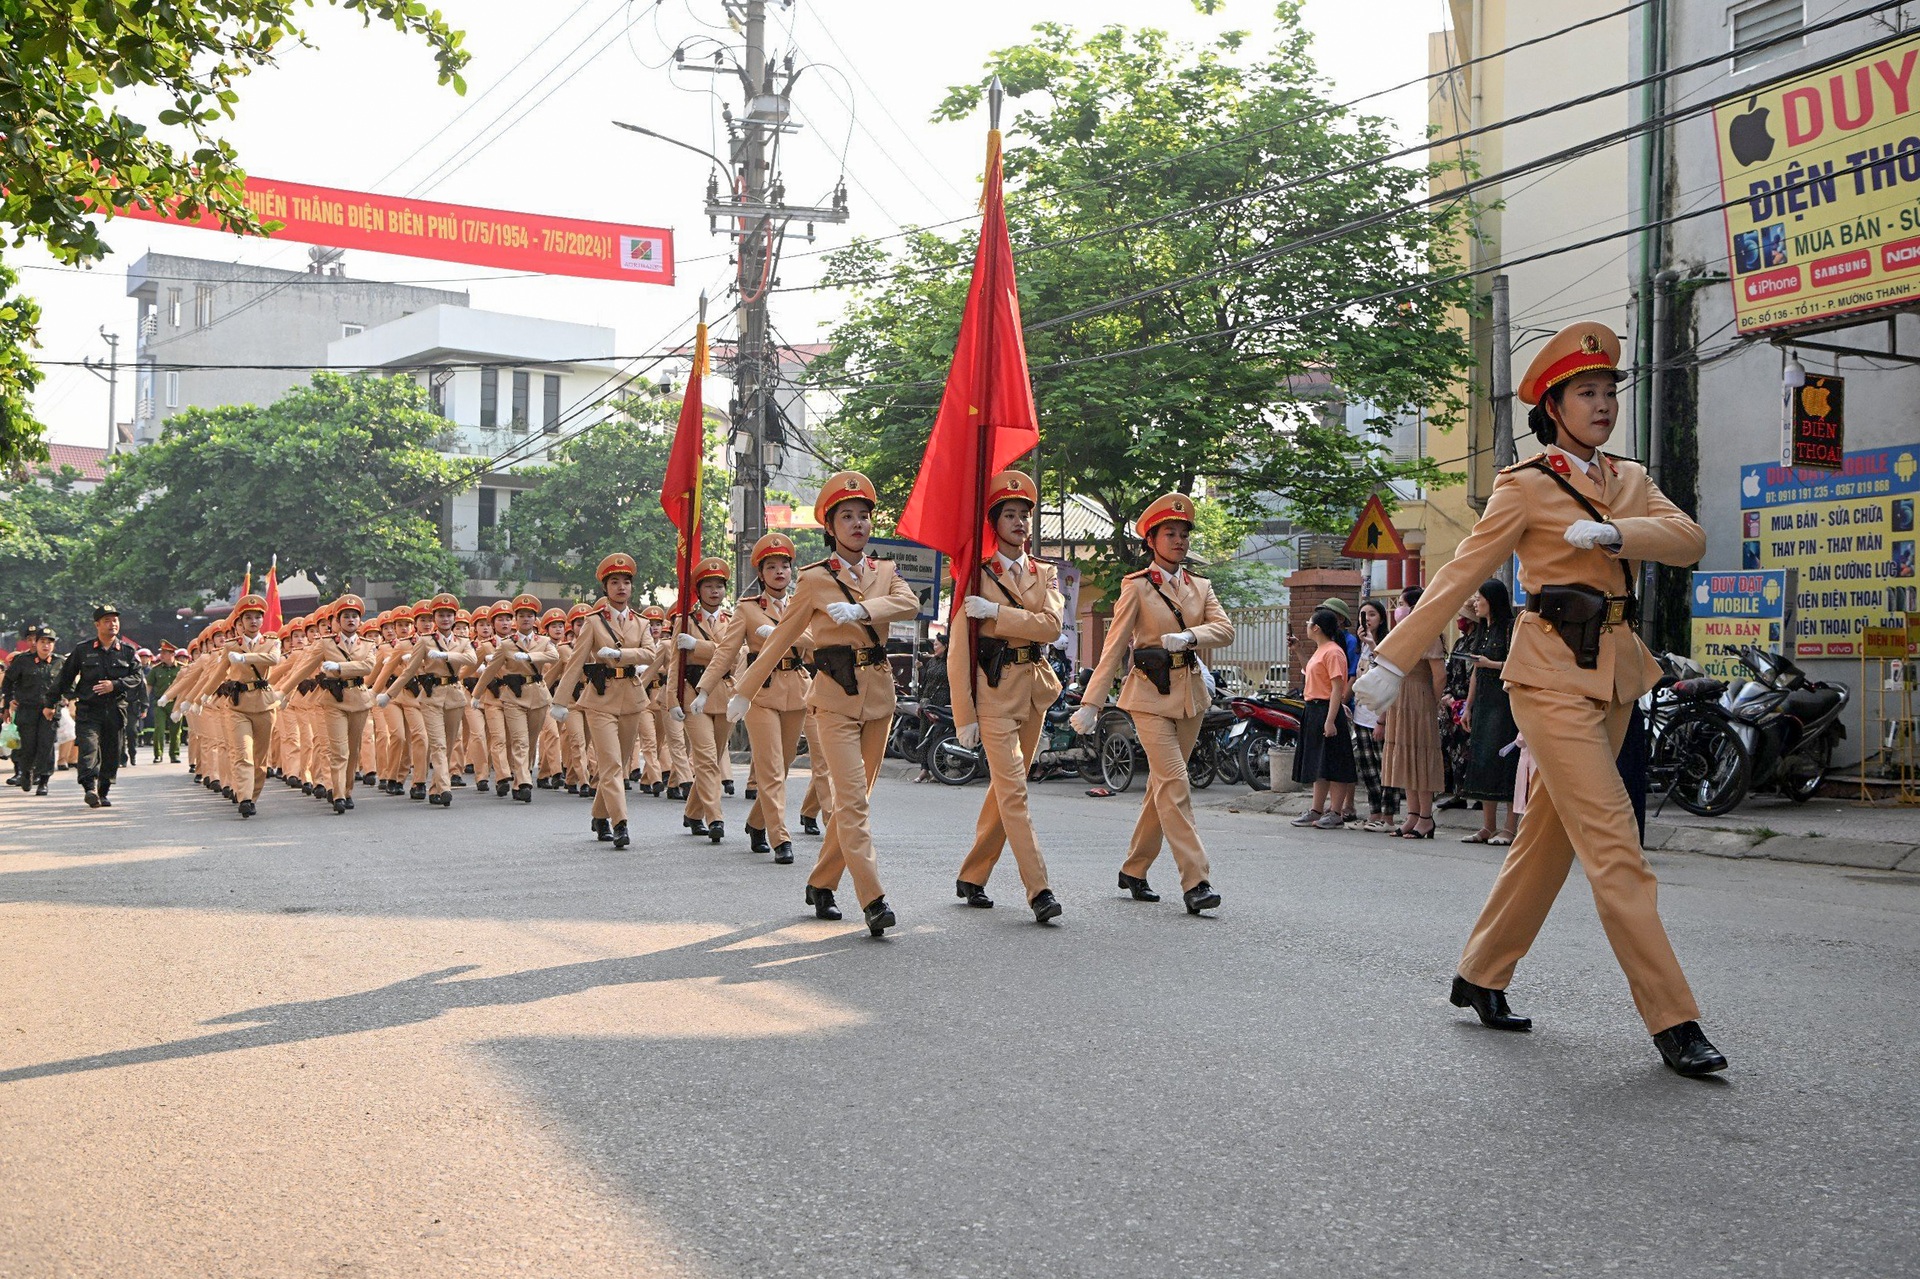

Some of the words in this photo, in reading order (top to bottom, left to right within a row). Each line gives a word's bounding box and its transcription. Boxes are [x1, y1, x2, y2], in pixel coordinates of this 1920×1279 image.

[1782, 49, 1919, 148] DUY
[1749, 160, 1837, 222] ĐIỆN
[292, 195, 344, 226] THẮNG
[347, 202, 385, 233] ĐIỆN
[388, 208, 424, 238] BIÊN
[428, 213, 458, 241] PHỦ
[461, 219, 529, 249] (7/5/1954
[541, 229, 612, 261] 7/5/2024)!
[1795, 229, 1835, 257] MUA
[1840, 215, 1881, 246] BÁN
[1814, 259, 1868, 280] SAMSUNG
[1758, 275, 1798, 294] iPhone
[1758, 309, 1772, 323] SỐ
[1810, 302, 1820, 312] 11
[1875, 284, 1911, 299] THANH
[1778, 489, 1797, 501] 0918
[1799, 487, 1812, 499] 191
[1814, 485, 1829, 498] 235
[1857, 481, 1873, 493] 819
[1771, 515, 1794, 532] MUA
[1796, 510, 1818, 529] BÁN
[1828, 504, 1850, 526] SỬA
[1853, 503, 1883, 524] CHỮA
[1771, 541, 1796, 557] THAY
[1799, 539, 1817, 555] PIN
[1827, 535, 1853, 553] THAY
[1856, 532, 1883, 550] MÀN
[1809, 563, 1833, 581] DÁN
[1834, 561, 1872, 580] CƯỜNG
[1875, 562, 1898, 581] LỰC
[1711, 576, 1736, 594] DUY
[1738, 575, 1763, 597] ĐẠT
[1713, 597, 1760, 614] MOBILE
[1822, 589, 1847, 611] ĐIỆN
[1850, 590, 1882, 610] THOẠI
[1705, 623, 1731, 636] MUA
[1735, 620, 1761, 636] BÁN
[1820, 618, 1851, 638] THOẠI
